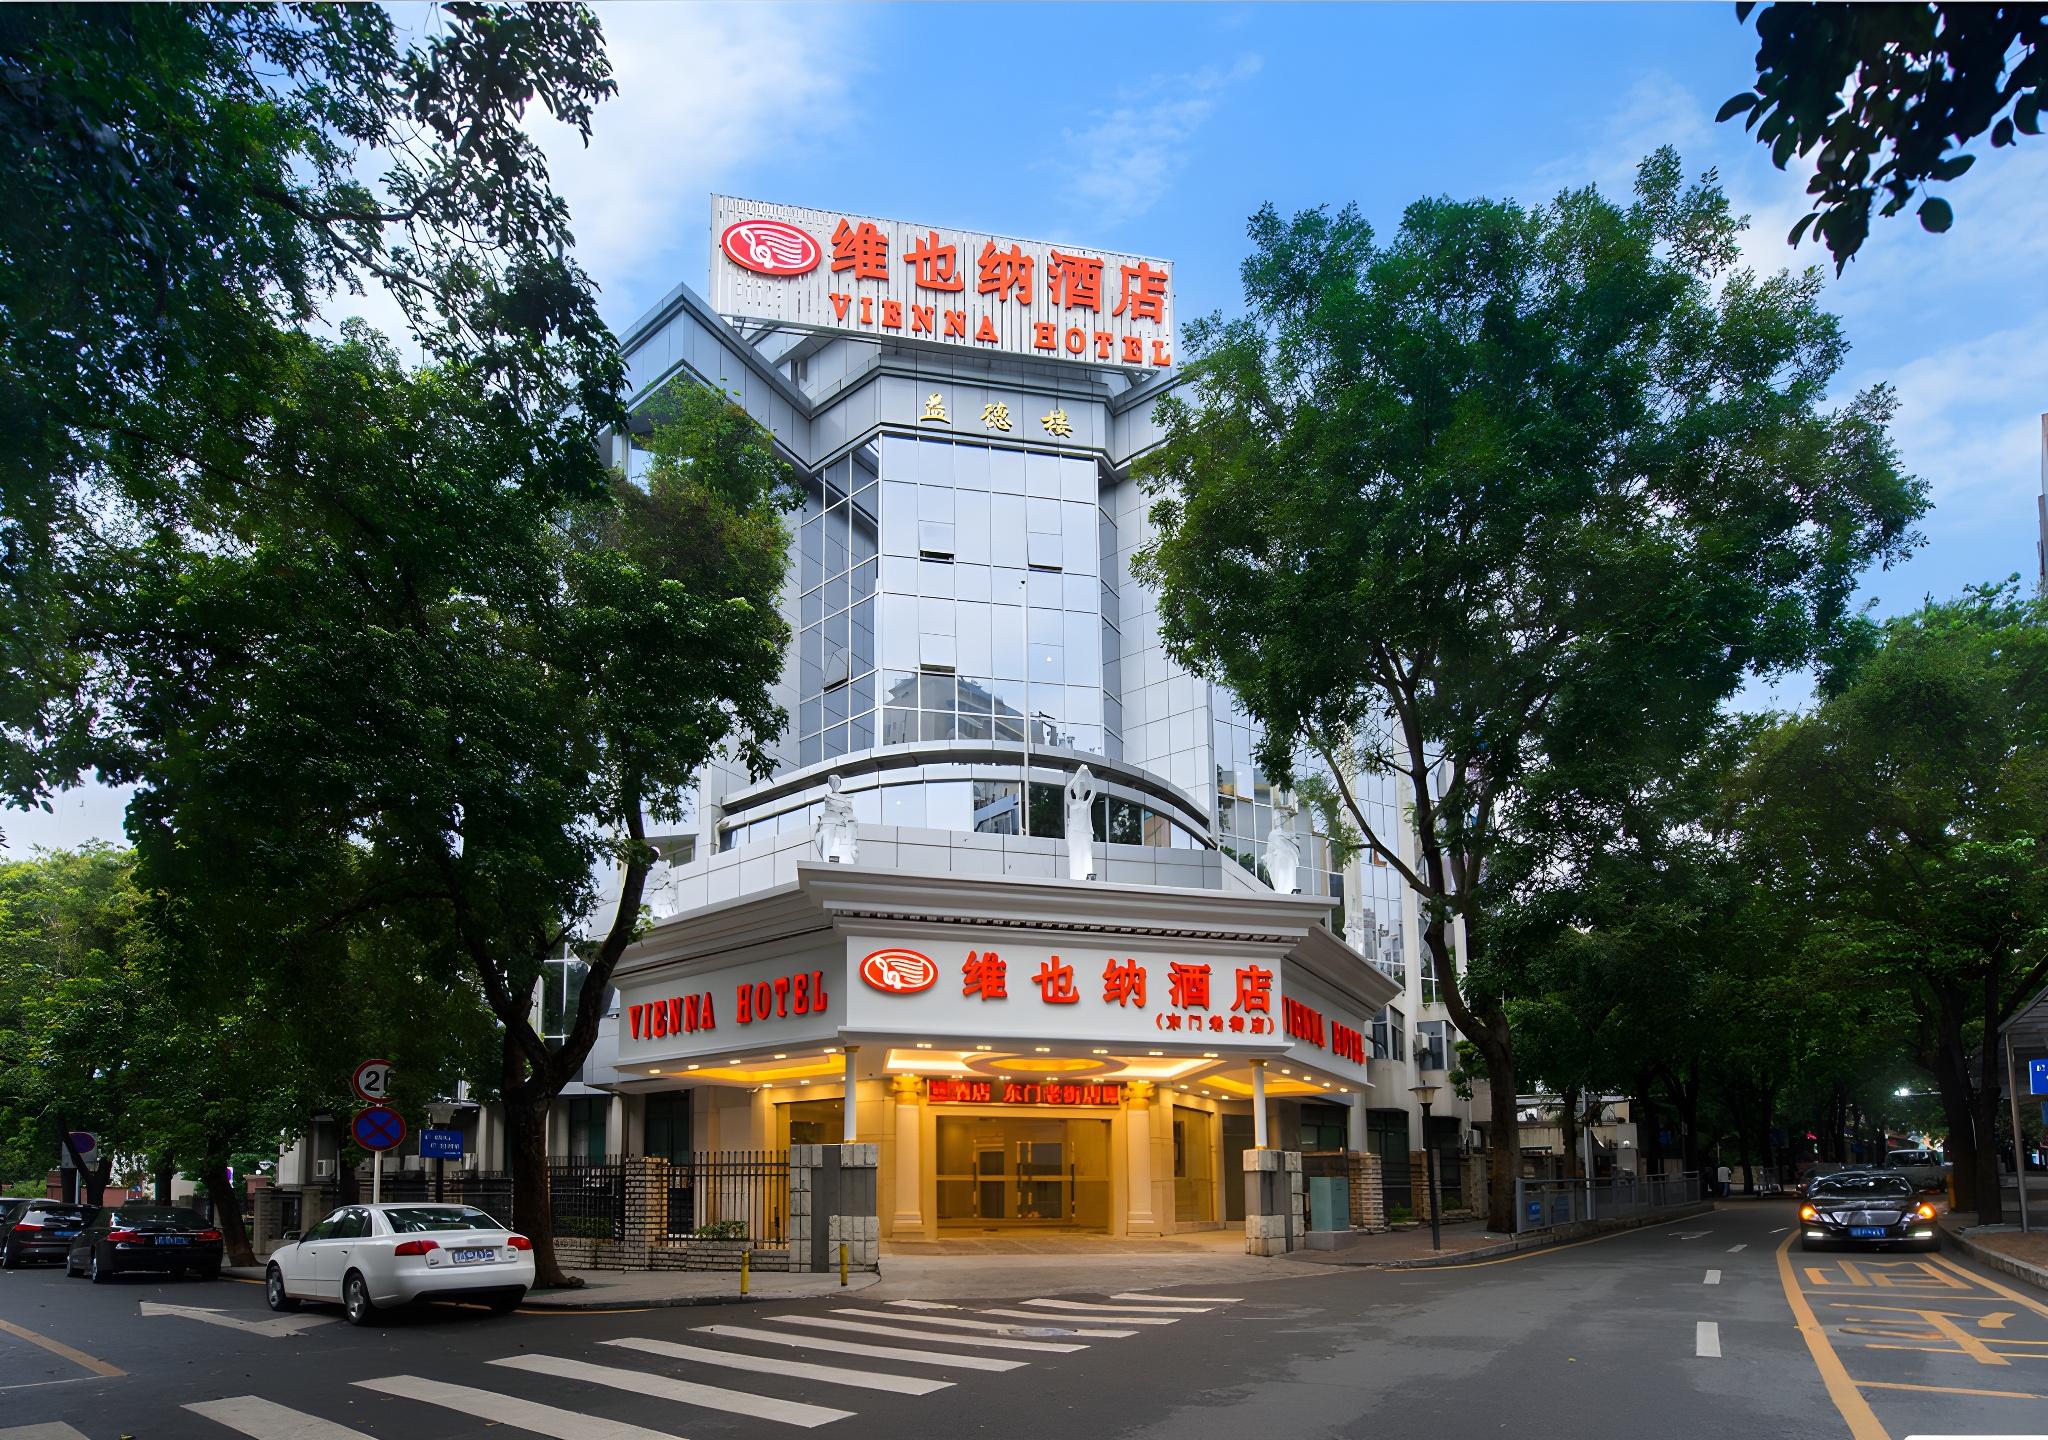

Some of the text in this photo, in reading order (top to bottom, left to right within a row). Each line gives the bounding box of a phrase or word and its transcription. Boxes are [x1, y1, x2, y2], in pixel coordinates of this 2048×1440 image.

[831, 218, 1170, 325] 维也纳酒店
[828, 293, 1171, 367] VIENNA HOTEL
[628, 970, 828, 1041] VIENNA HOTEL
[961, 950, 1275, 1014] 维也纳酒店
